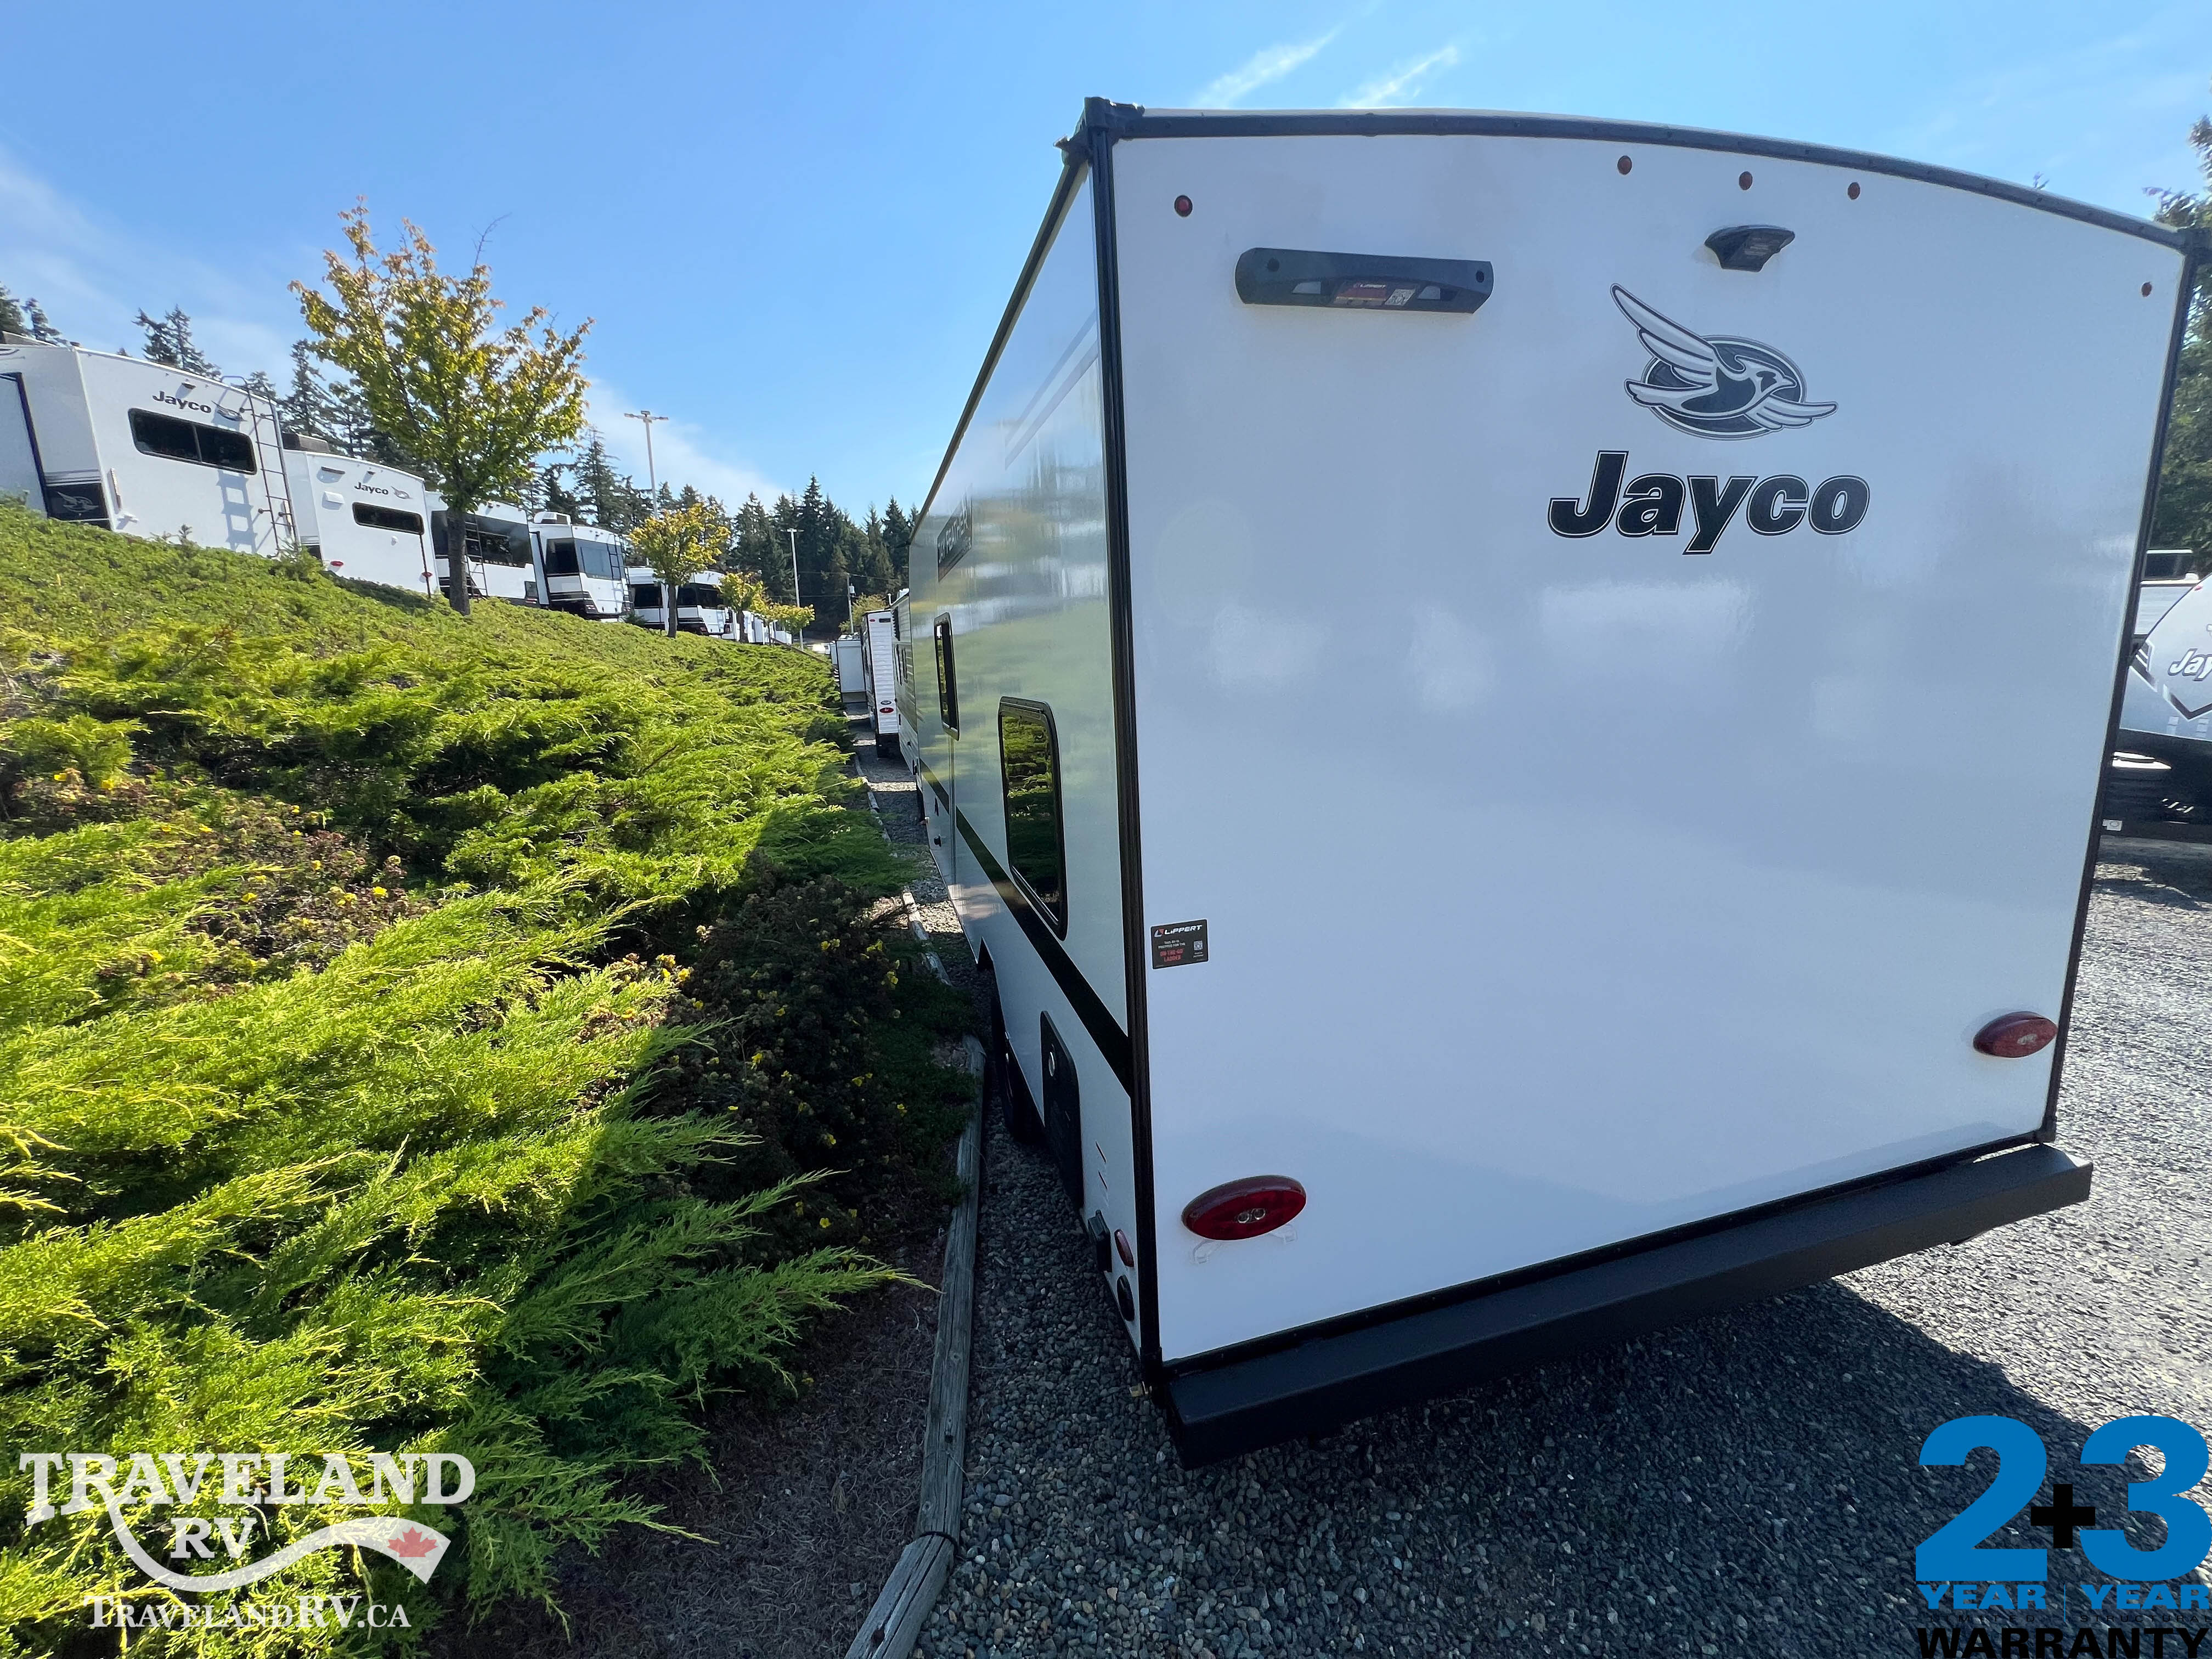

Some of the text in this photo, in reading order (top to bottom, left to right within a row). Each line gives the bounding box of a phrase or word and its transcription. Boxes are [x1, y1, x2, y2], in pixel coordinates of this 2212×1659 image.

[152, 390, 212, 414] Jayco
[354, 482, 388, 495] Jayco
[1547, 449, 1871, 555] Jayco
[1164, 924, 1203, 935] LIPPERT
